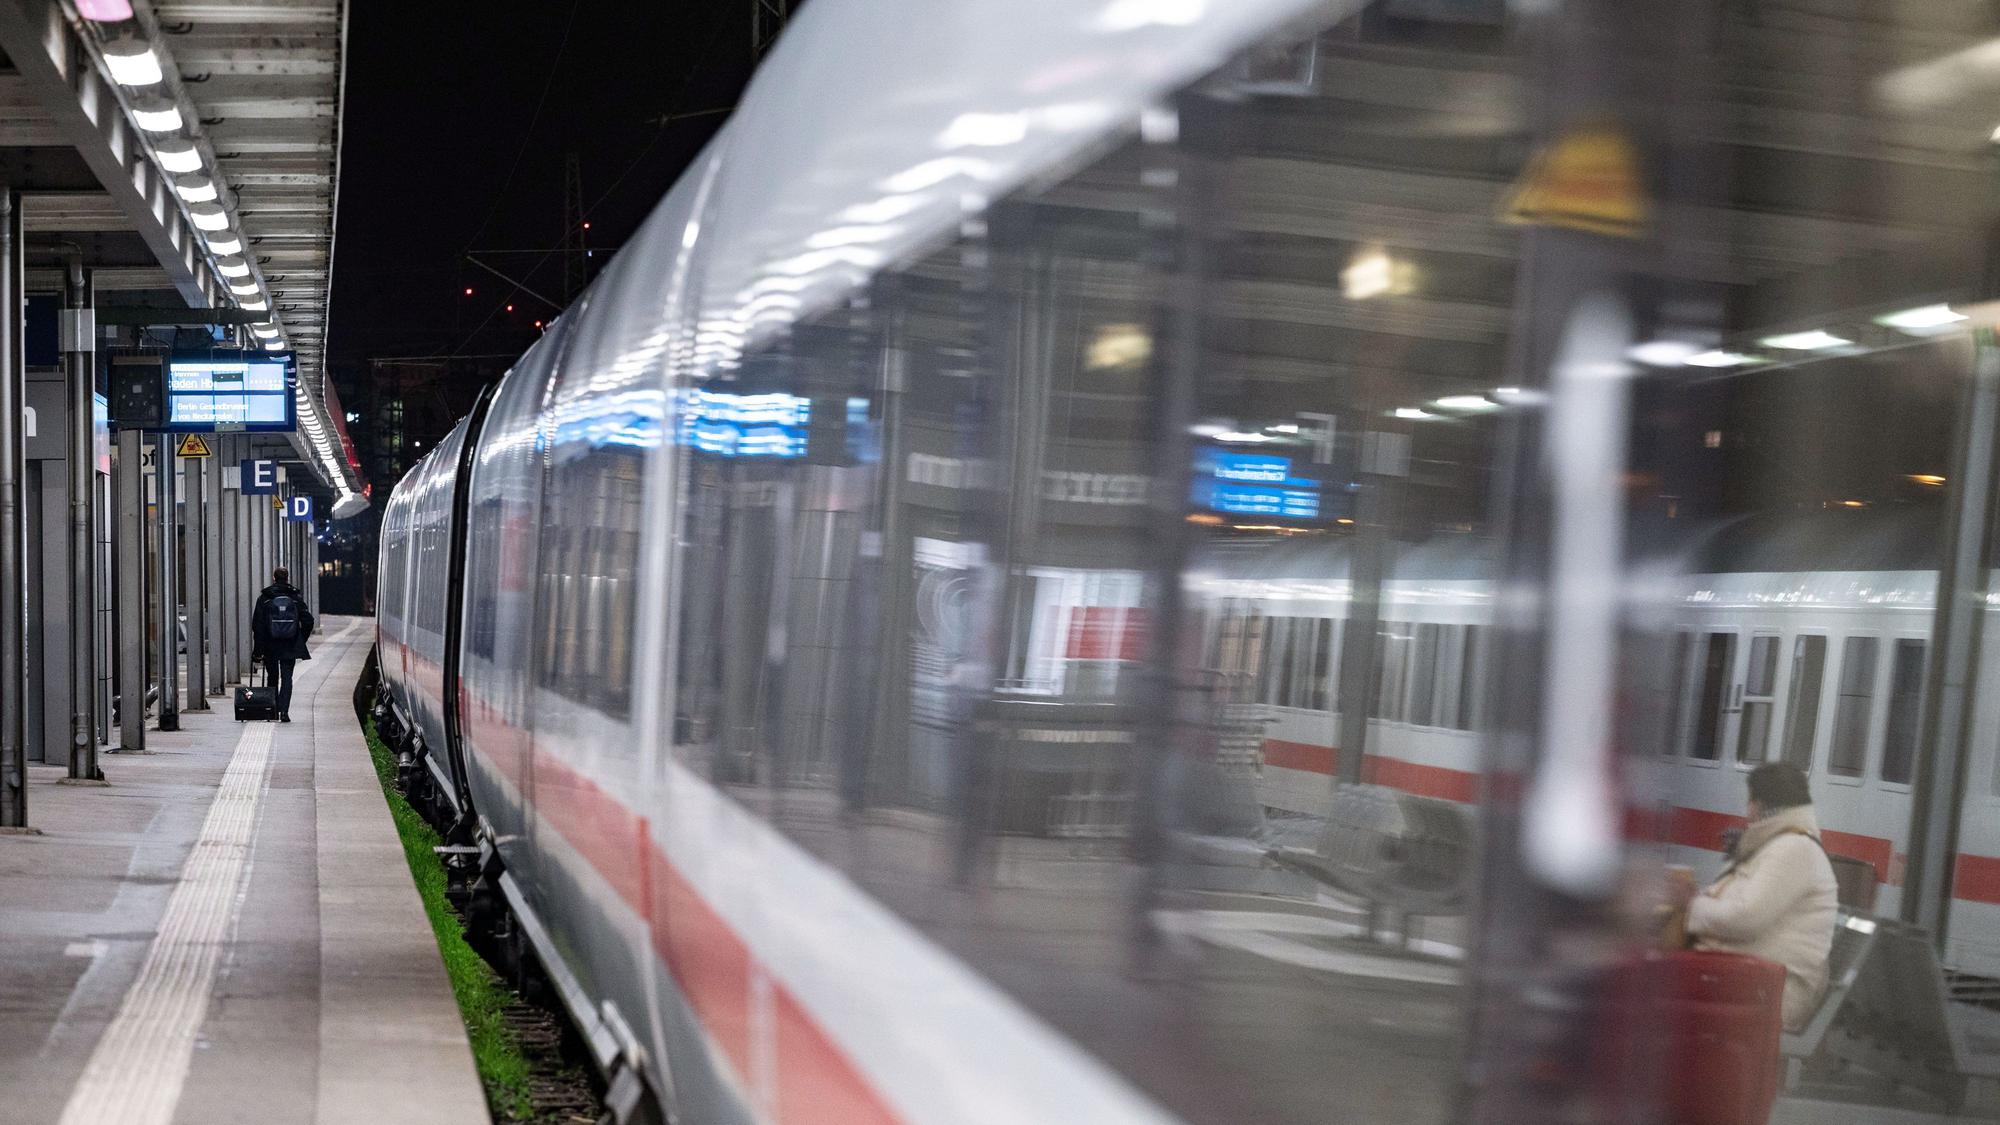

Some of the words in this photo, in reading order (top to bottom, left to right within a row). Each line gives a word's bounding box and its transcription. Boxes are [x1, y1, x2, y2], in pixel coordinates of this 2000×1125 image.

[178, 402, 198, 410] Berlin
[254, 460, 272, 487] E
[294, 497, 309, 516] D
